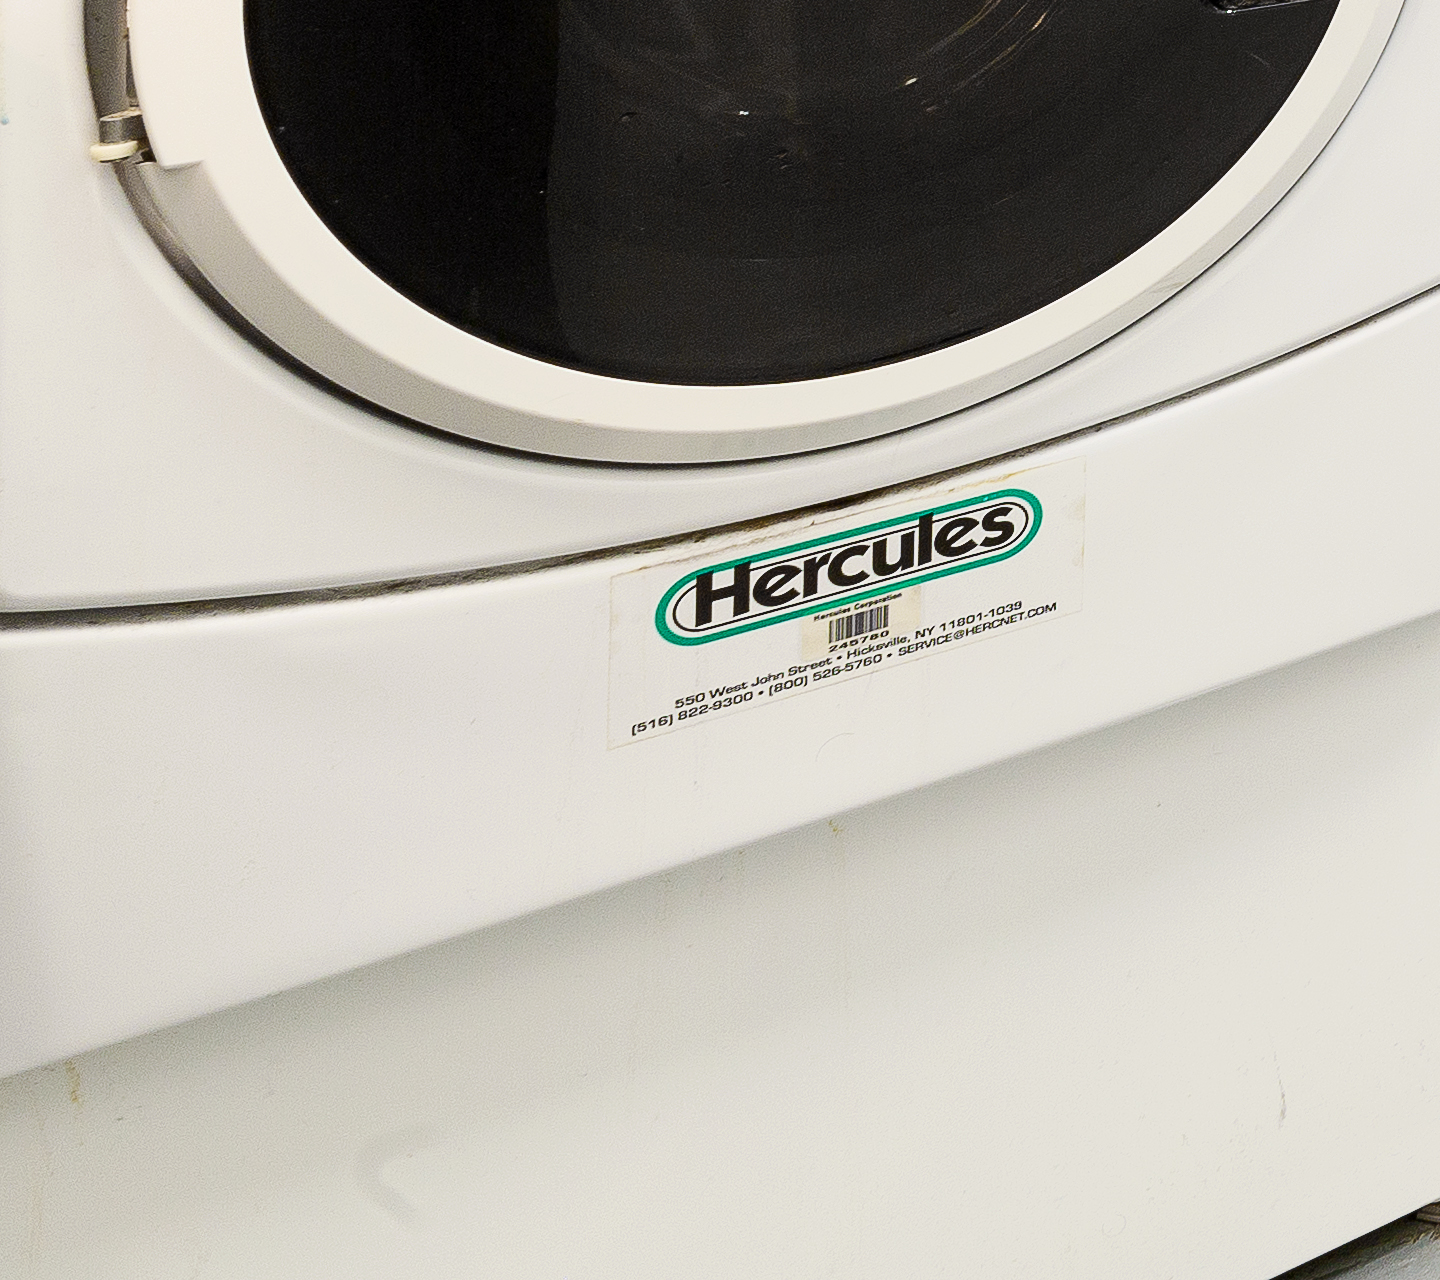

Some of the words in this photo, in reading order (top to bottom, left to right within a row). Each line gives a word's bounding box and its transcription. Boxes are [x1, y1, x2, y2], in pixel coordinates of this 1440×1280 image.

[695, 506, 1015, 627] Hercules
[631, 713, 674, 736] (516)
[678, 691, 754, 722] 822-9300
[768, 676, 809, 697] (800)
[812, 653, 882, 682] 526-5760
[897, 602, 1058, 658] SERVICE@HERCNET.COM
[675, 692, 705, 709] 550
[709, 681, 748, 699] West
[751, 670, 785, 688] John
[788, 656, 832, 678] Street
[846, 634, 911, 661] Hicksville,
[914, 624, 936, 640] NY
[938, 600, 1023, 633] 11801-1039
